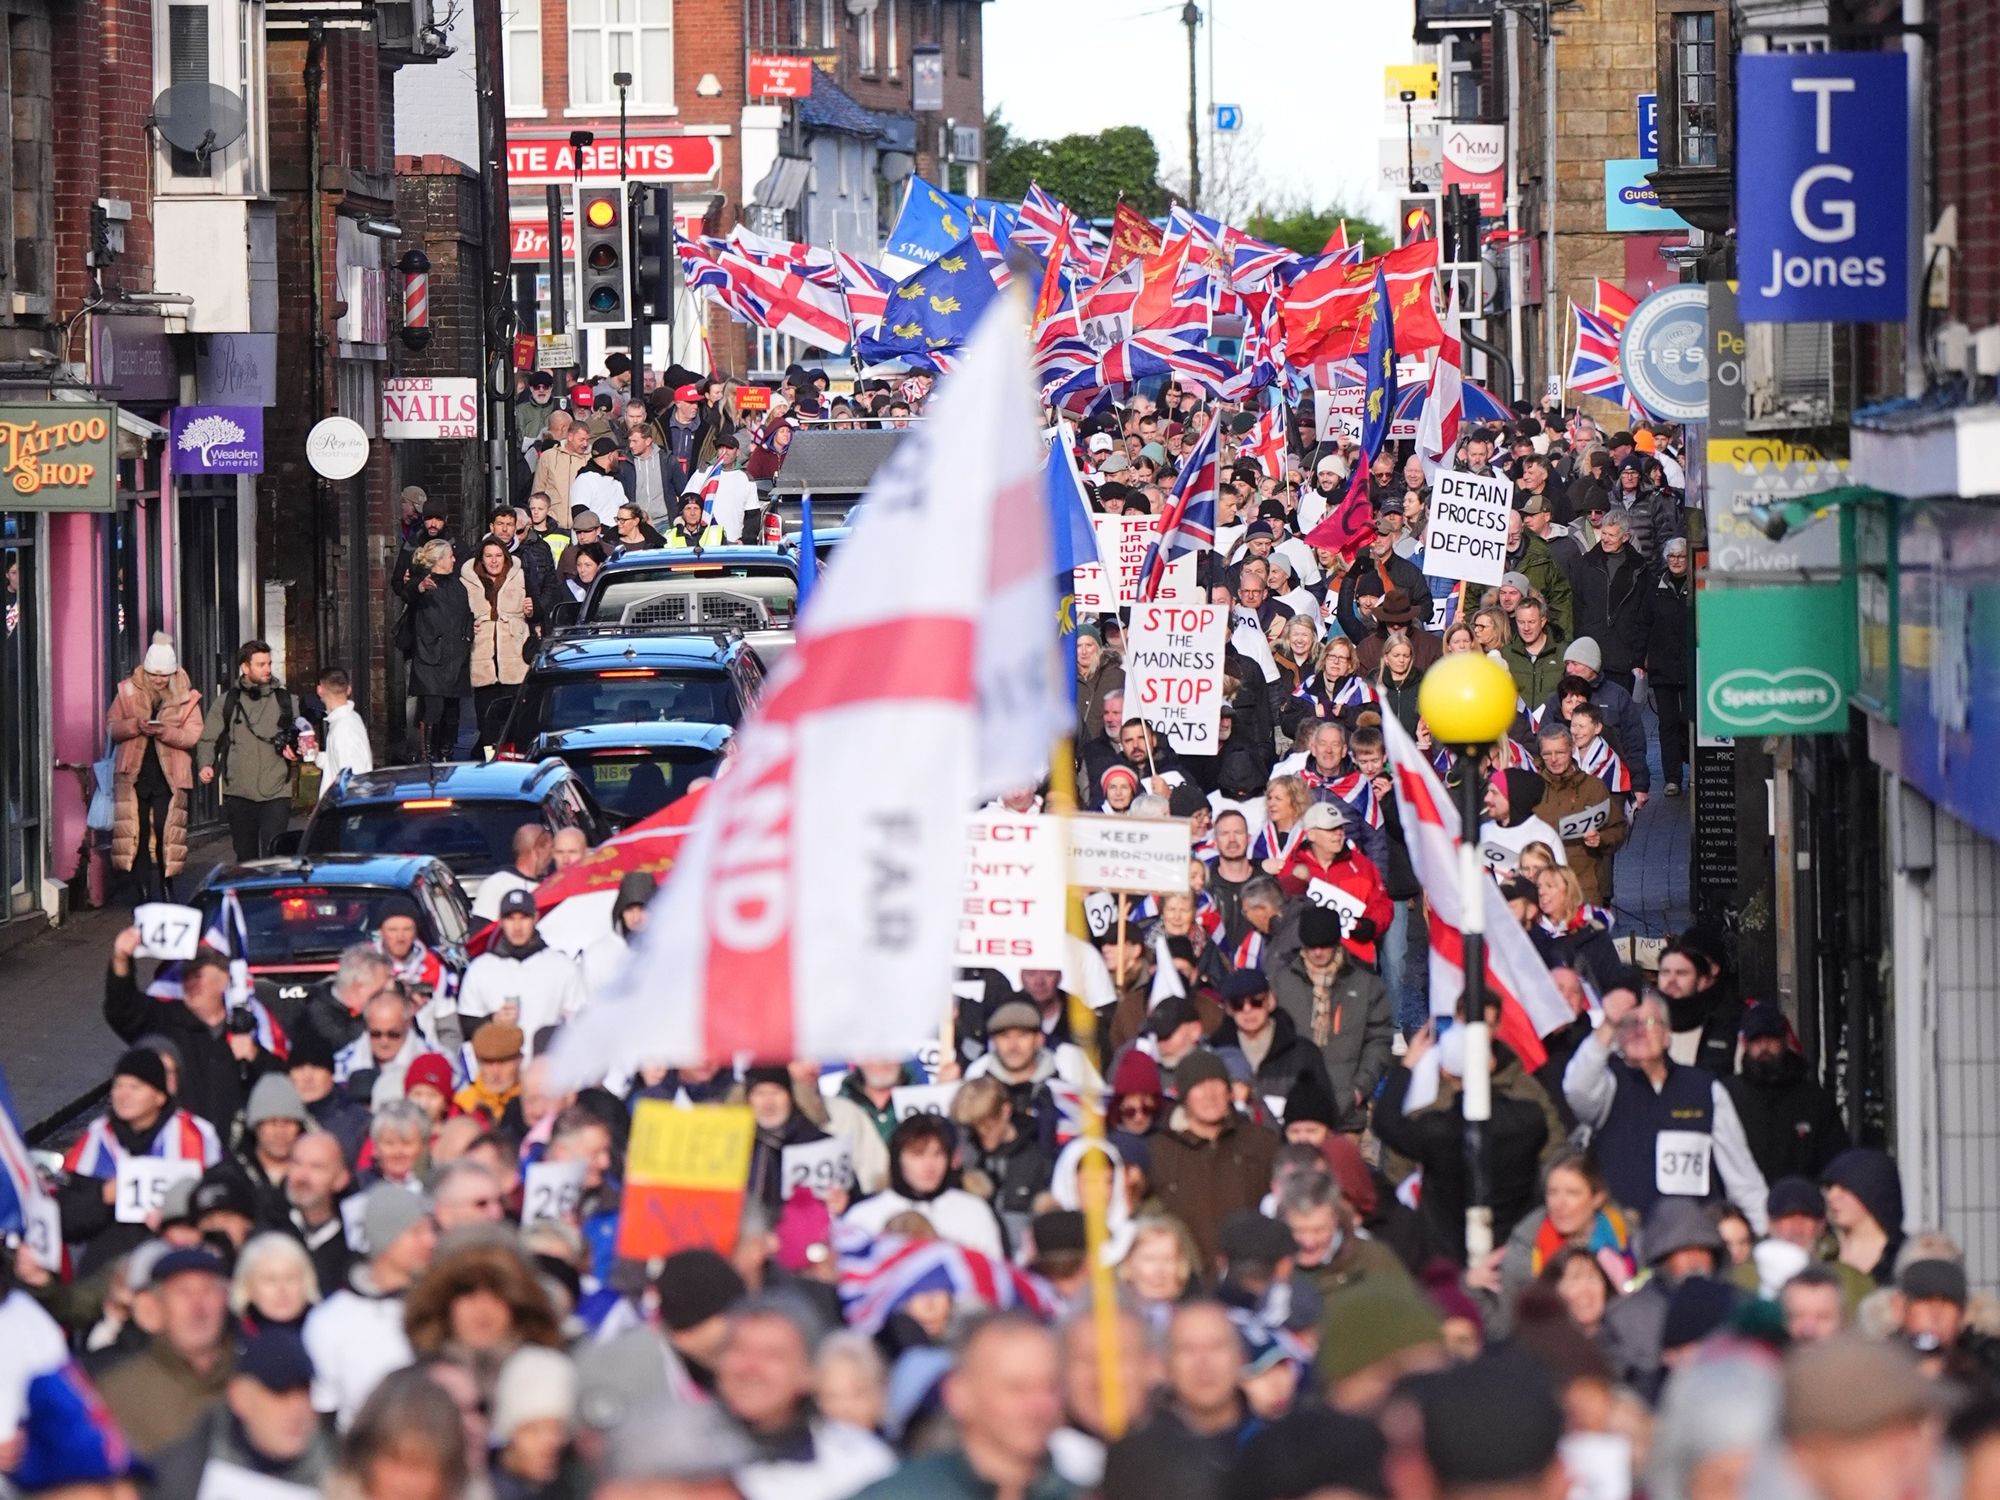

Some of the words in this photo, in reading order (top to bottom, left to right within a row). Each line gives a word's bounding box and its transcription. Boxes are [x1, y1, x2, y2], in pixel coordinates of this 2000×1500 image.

[1791, 78, 1855, 153] T
[554, 145, 673, 171] AGENTS
[1466, 142, 1499, 154] KMJ
[1473, 182, 1492, 190] Local
[1790, 164, 1856, 243] G
[1760, 249, 1887, 298] Jones
[384, 379, 432, 391] LUXE
[384, 395, 476, 422] NAILS
[438, 425, 477, 438] BAR
[0, 417, 108, 473] TATTOO
[210, 449, 258, 460] Wealden
[13, 456, 96, 493] SHOP
[212, 459, 258, 467] Funerals
[1441, 478, 1508, 507] DETAIN
[1437, 502, 1507, 532] PROCESS
[1430, 531, 1505, 561] DEPORT
[1144, 608, 1214, 632] STOP
[1166, 634, 1193, 647] THE
[1133, 651, 1215, 670] MADNESS
[1141, 678, 1213, 704] STOP
[1721, 687, 1828, 708] Specsavers
[1161, 707, 1188, 719] THE
[1564, 811, 1606, 837] 279
[1100, 831, 1149, 843] KEEP
[1640, 939, 1662, 951] NO!
[1663, 1151, 1704, 1178] 376
